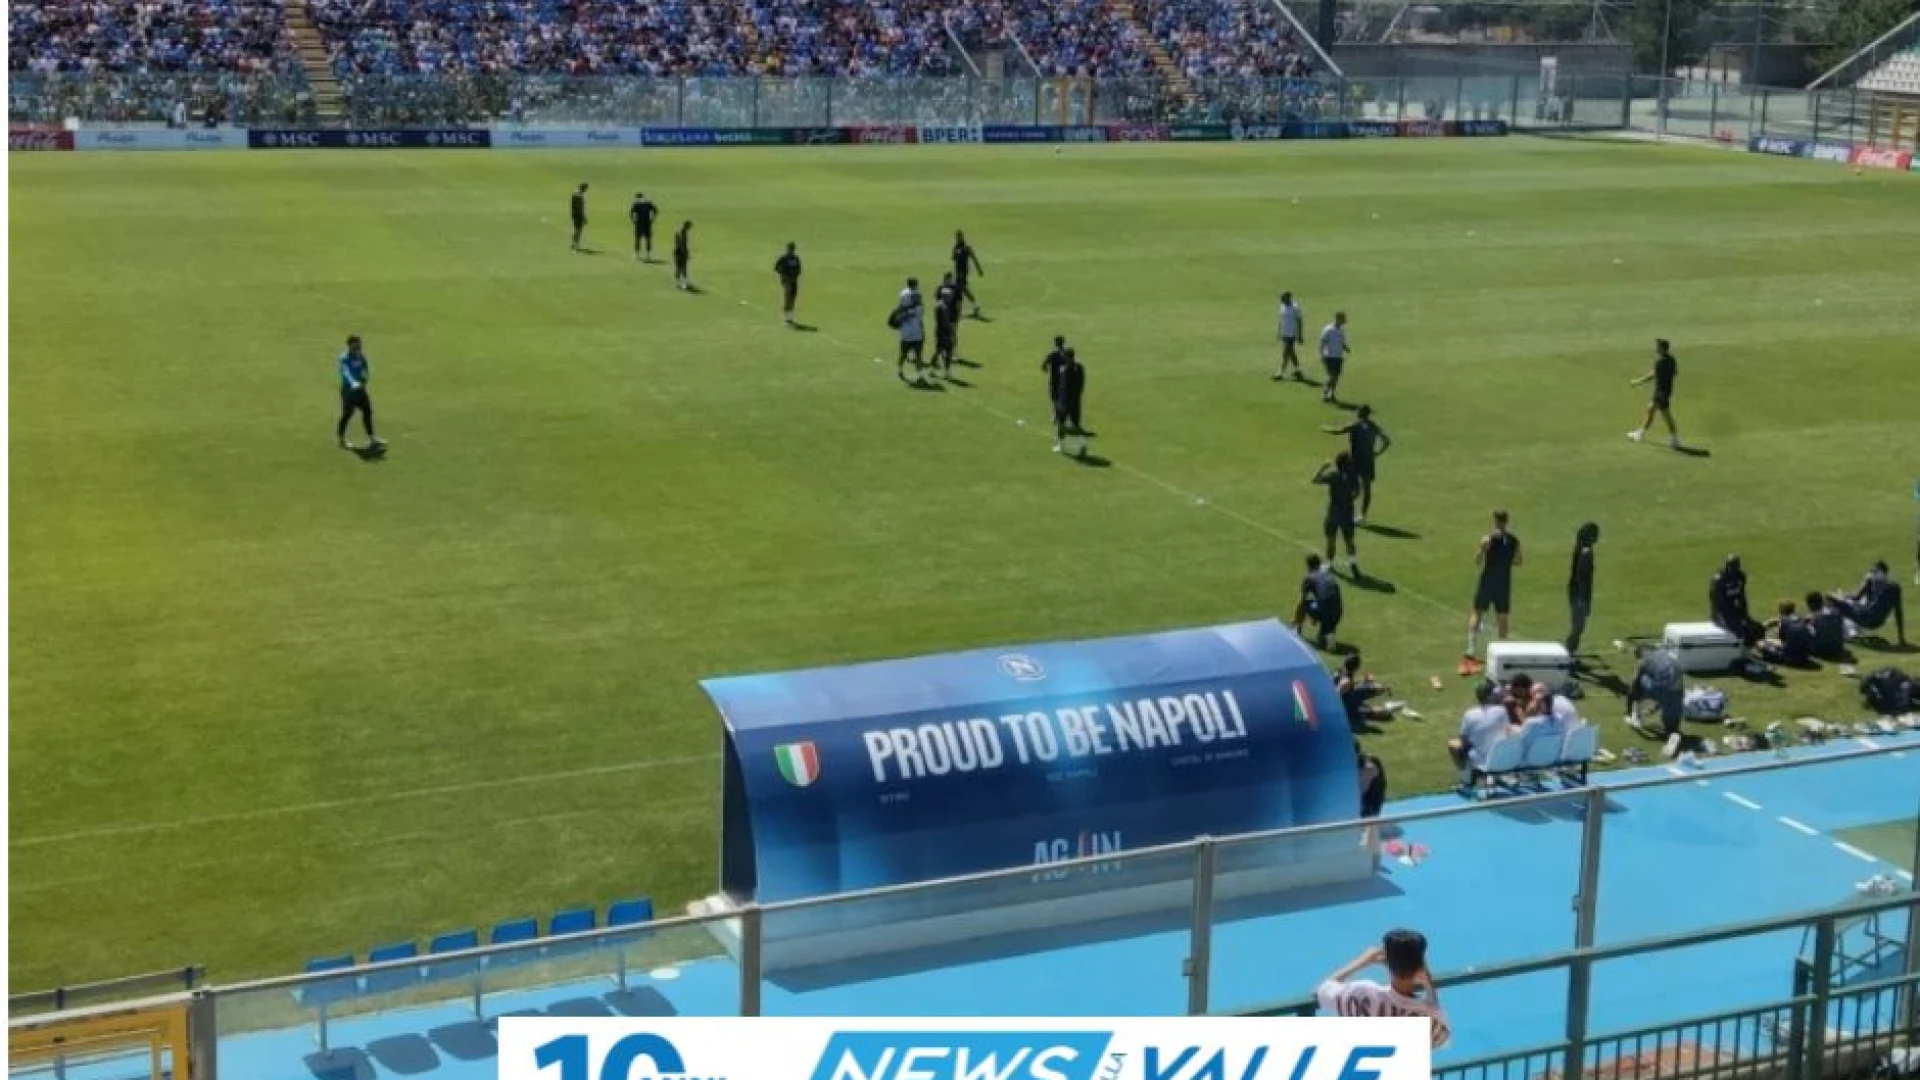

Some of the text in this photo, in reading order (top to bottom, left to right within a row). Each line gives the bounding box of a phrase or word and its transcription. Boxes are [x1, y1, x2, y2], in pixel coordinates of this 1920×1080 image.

[862, 689, 1248, 783] PROUD TO BE NAPOLI
